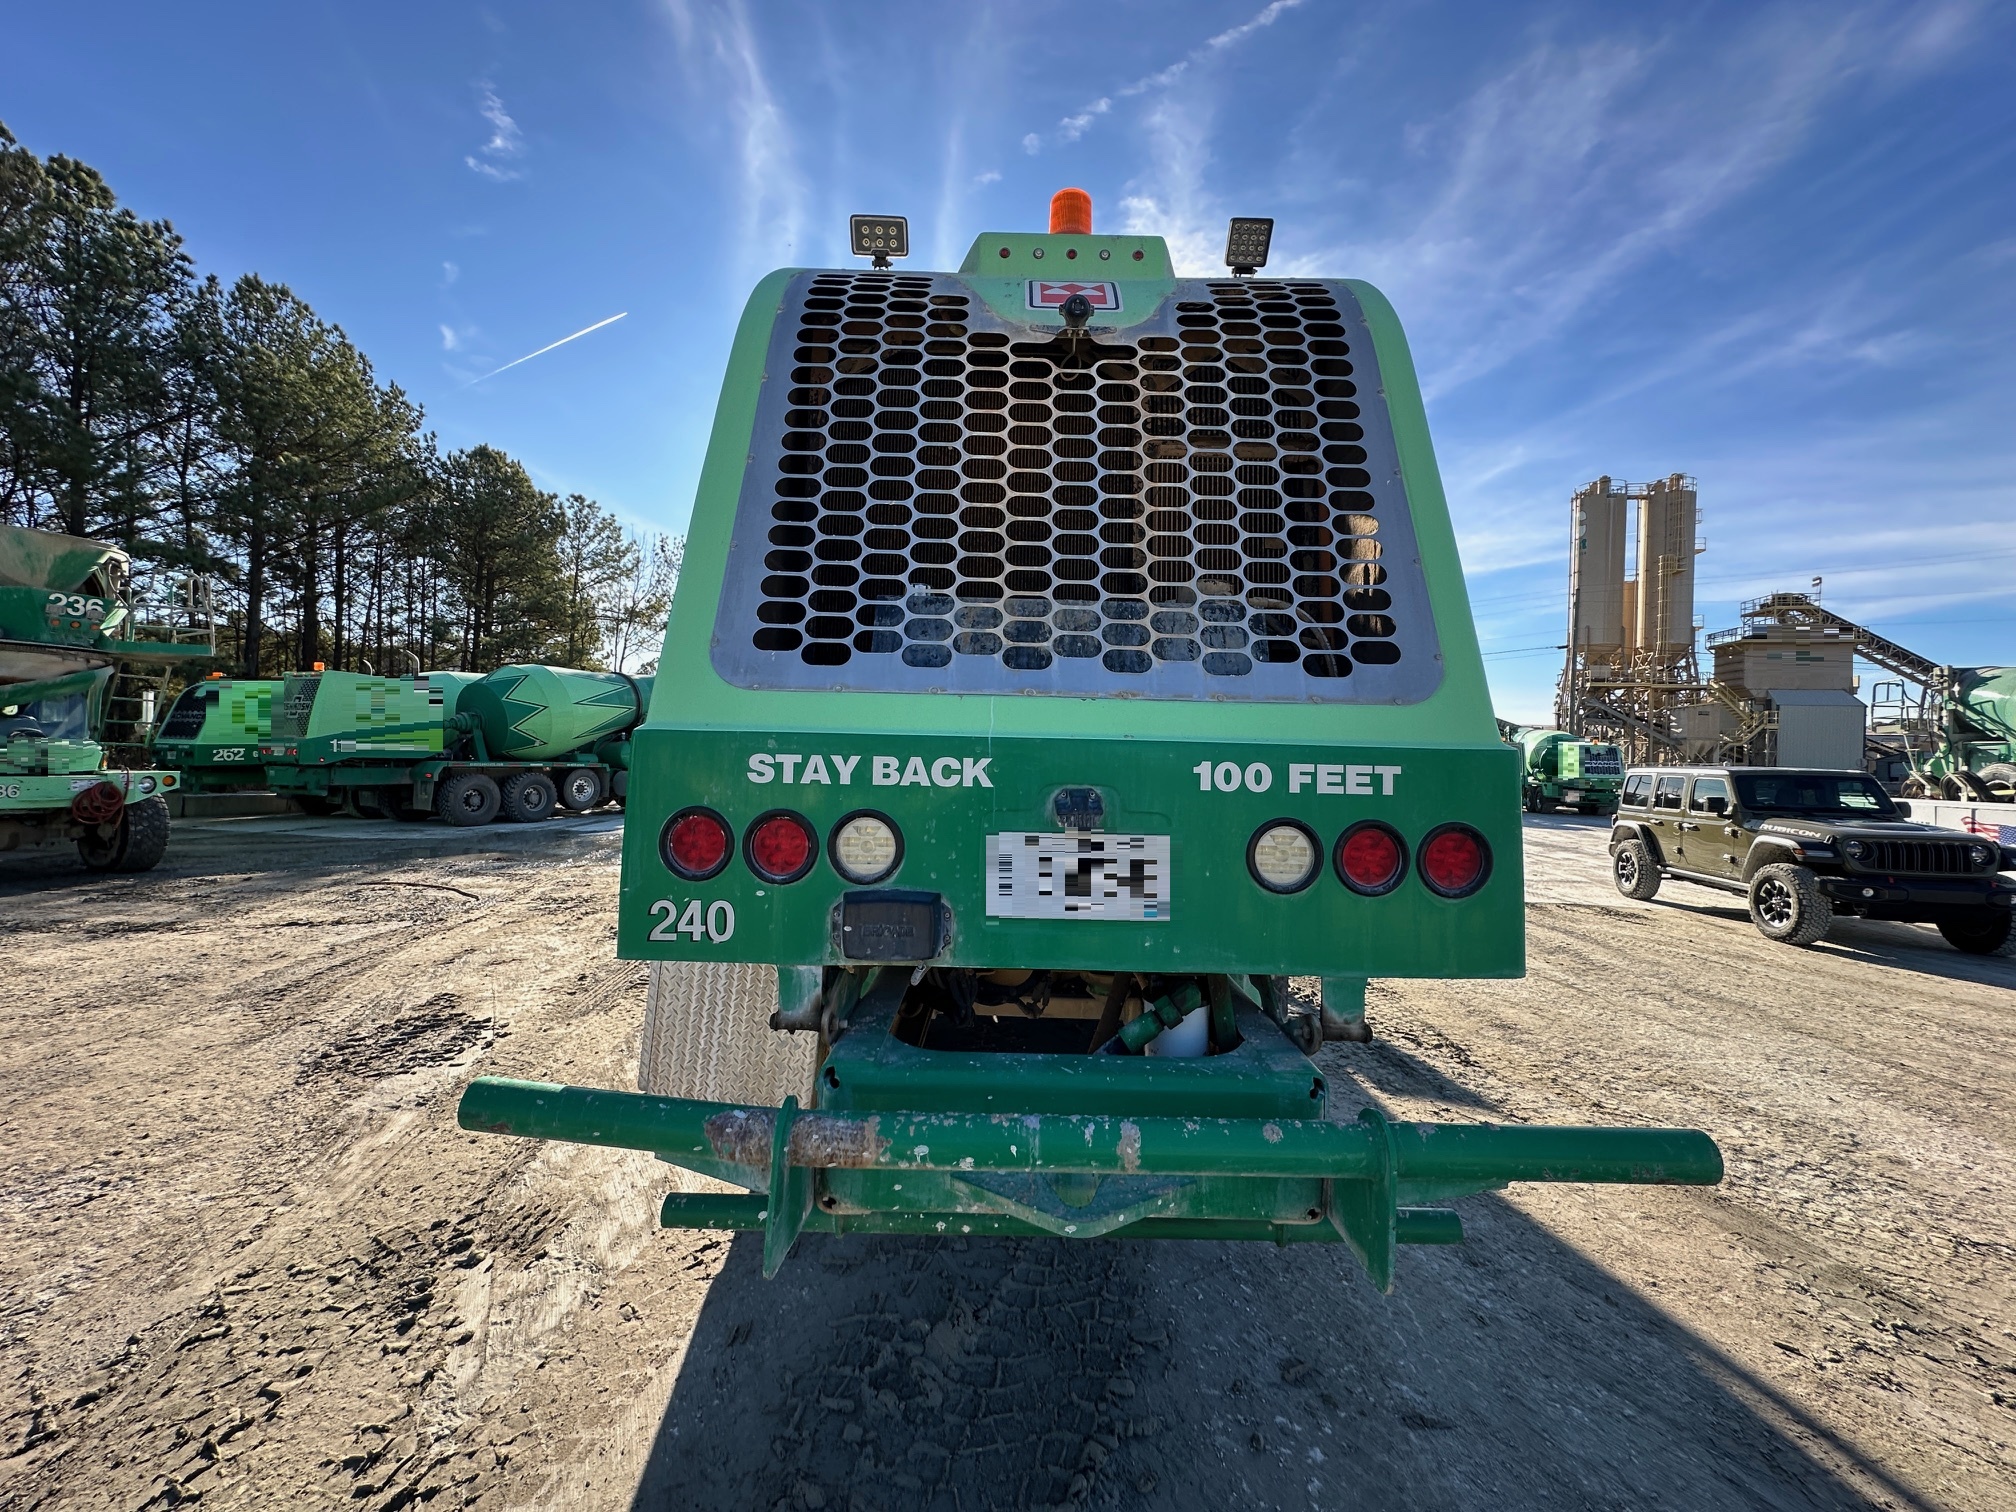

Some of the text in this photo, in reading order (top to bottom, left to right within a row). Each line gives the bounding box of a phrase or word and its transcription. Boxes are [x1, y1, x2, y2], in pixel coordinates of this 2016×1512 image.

[48, 593, 104, 616] 236
[212, 748, 245, 761] 262
[747, 753, 994, 788] STAY BACK
[1193, 761, 1402, 796] 100 FEET
[1760, 823, 1822, 838] RUBICON
[647, 898, 735, 943] 240
